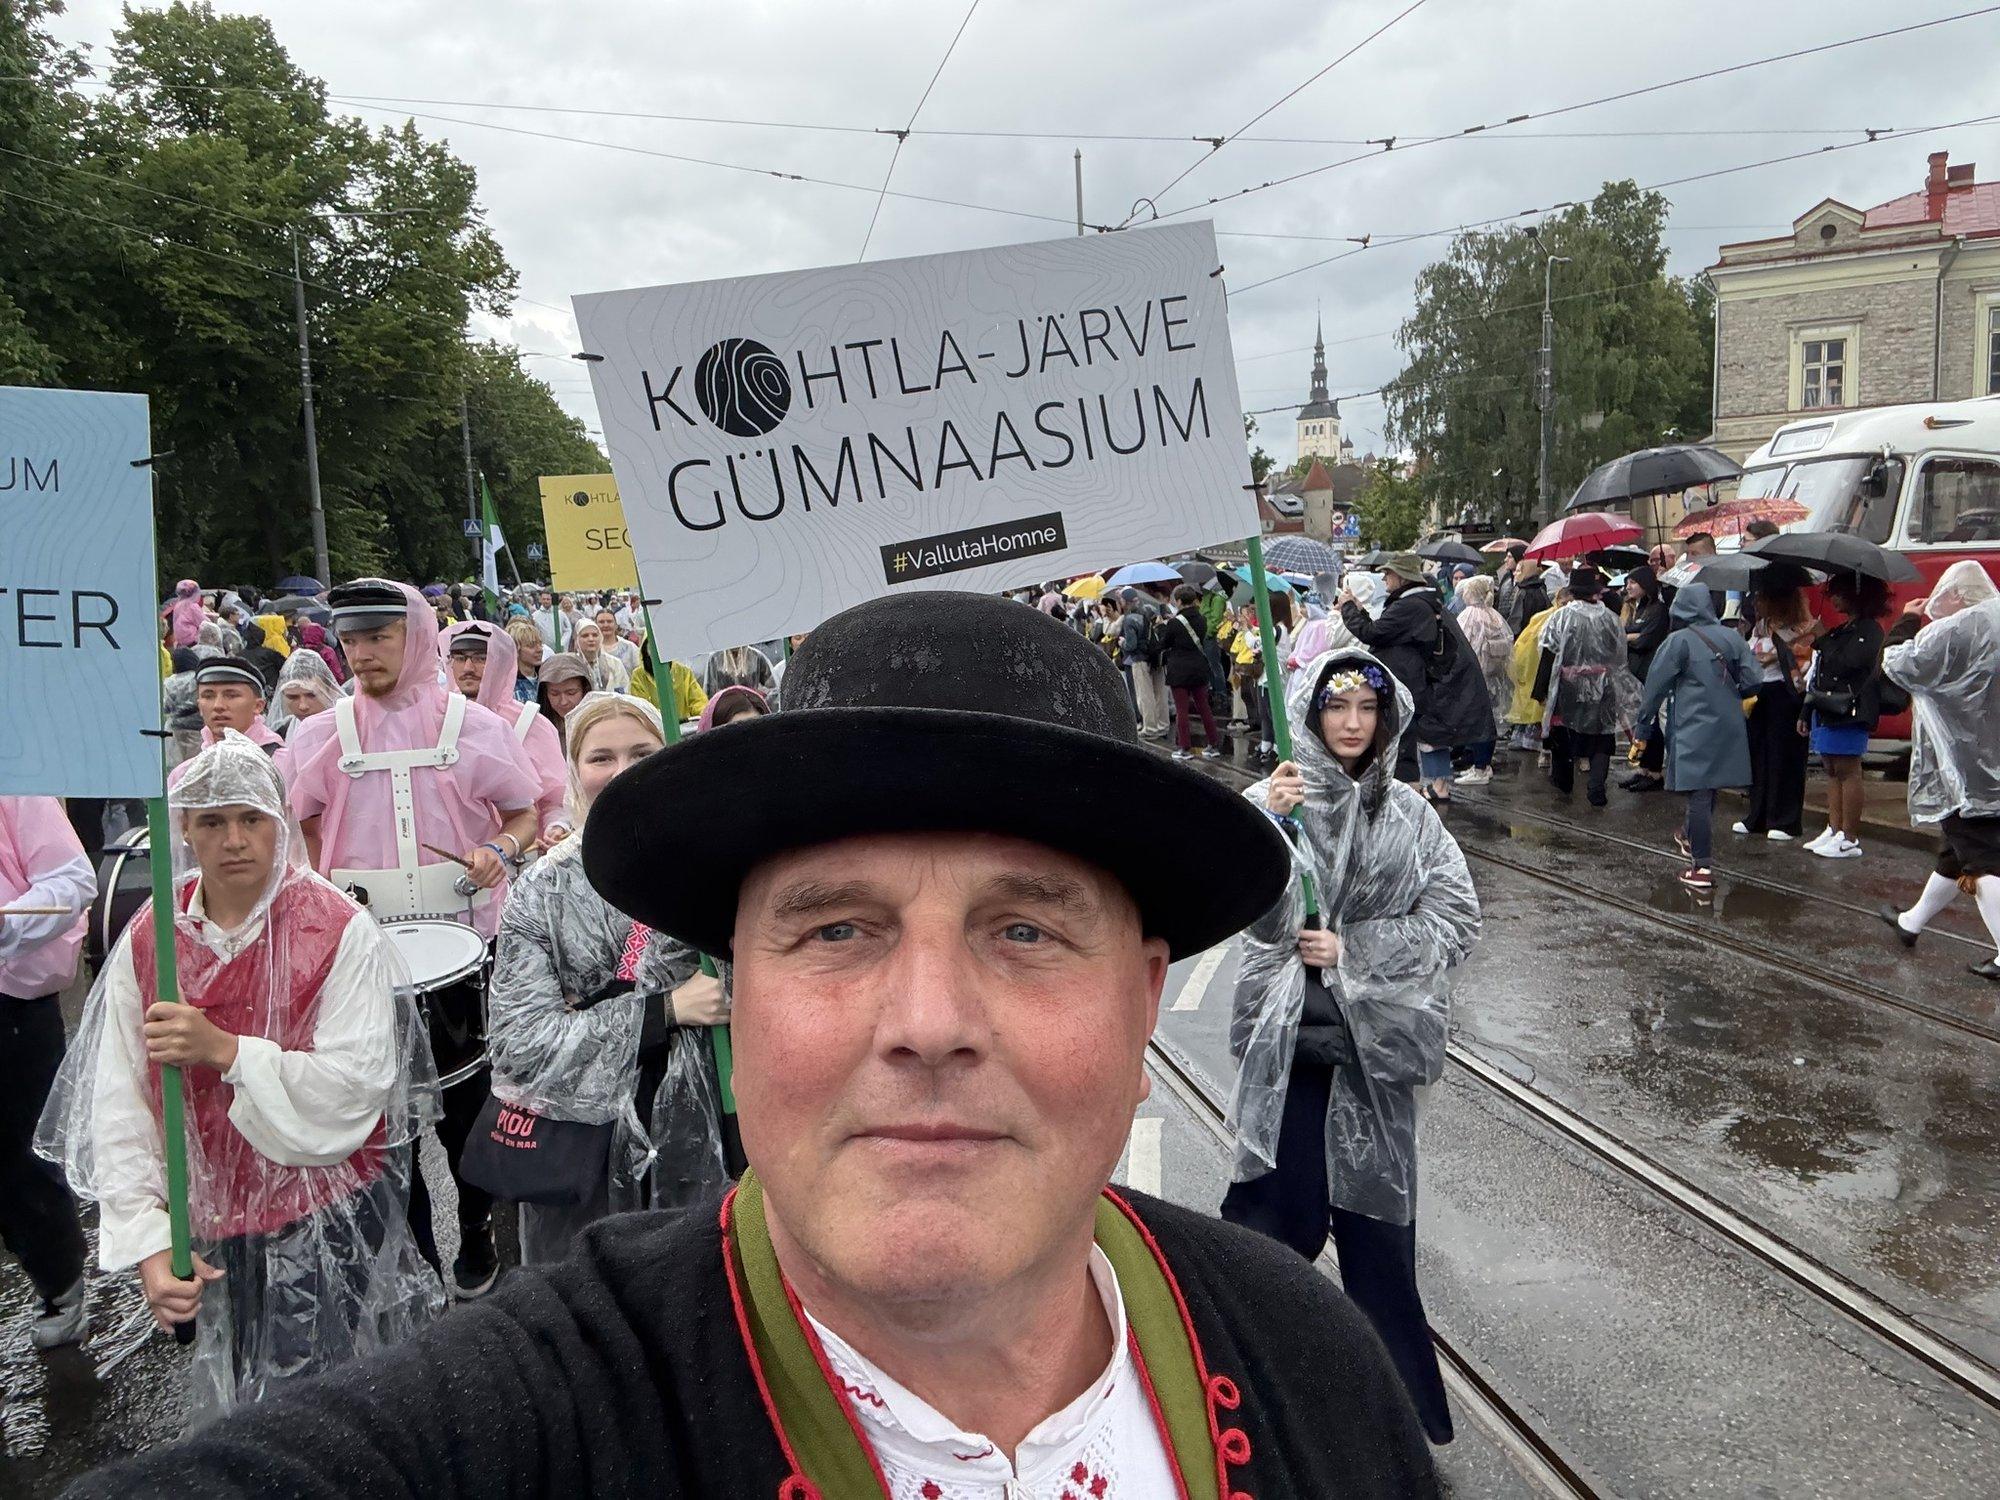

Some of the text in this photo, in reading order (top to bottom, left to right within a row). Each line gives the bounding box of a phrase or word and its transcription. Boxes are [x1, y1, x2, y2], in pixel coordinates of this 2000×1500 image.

[667, 377, 1211, 532] GÜMNAASIUM
[893, 526, 1057, 573] #VallutaHomne
[0, 587, 121, 650] ER
